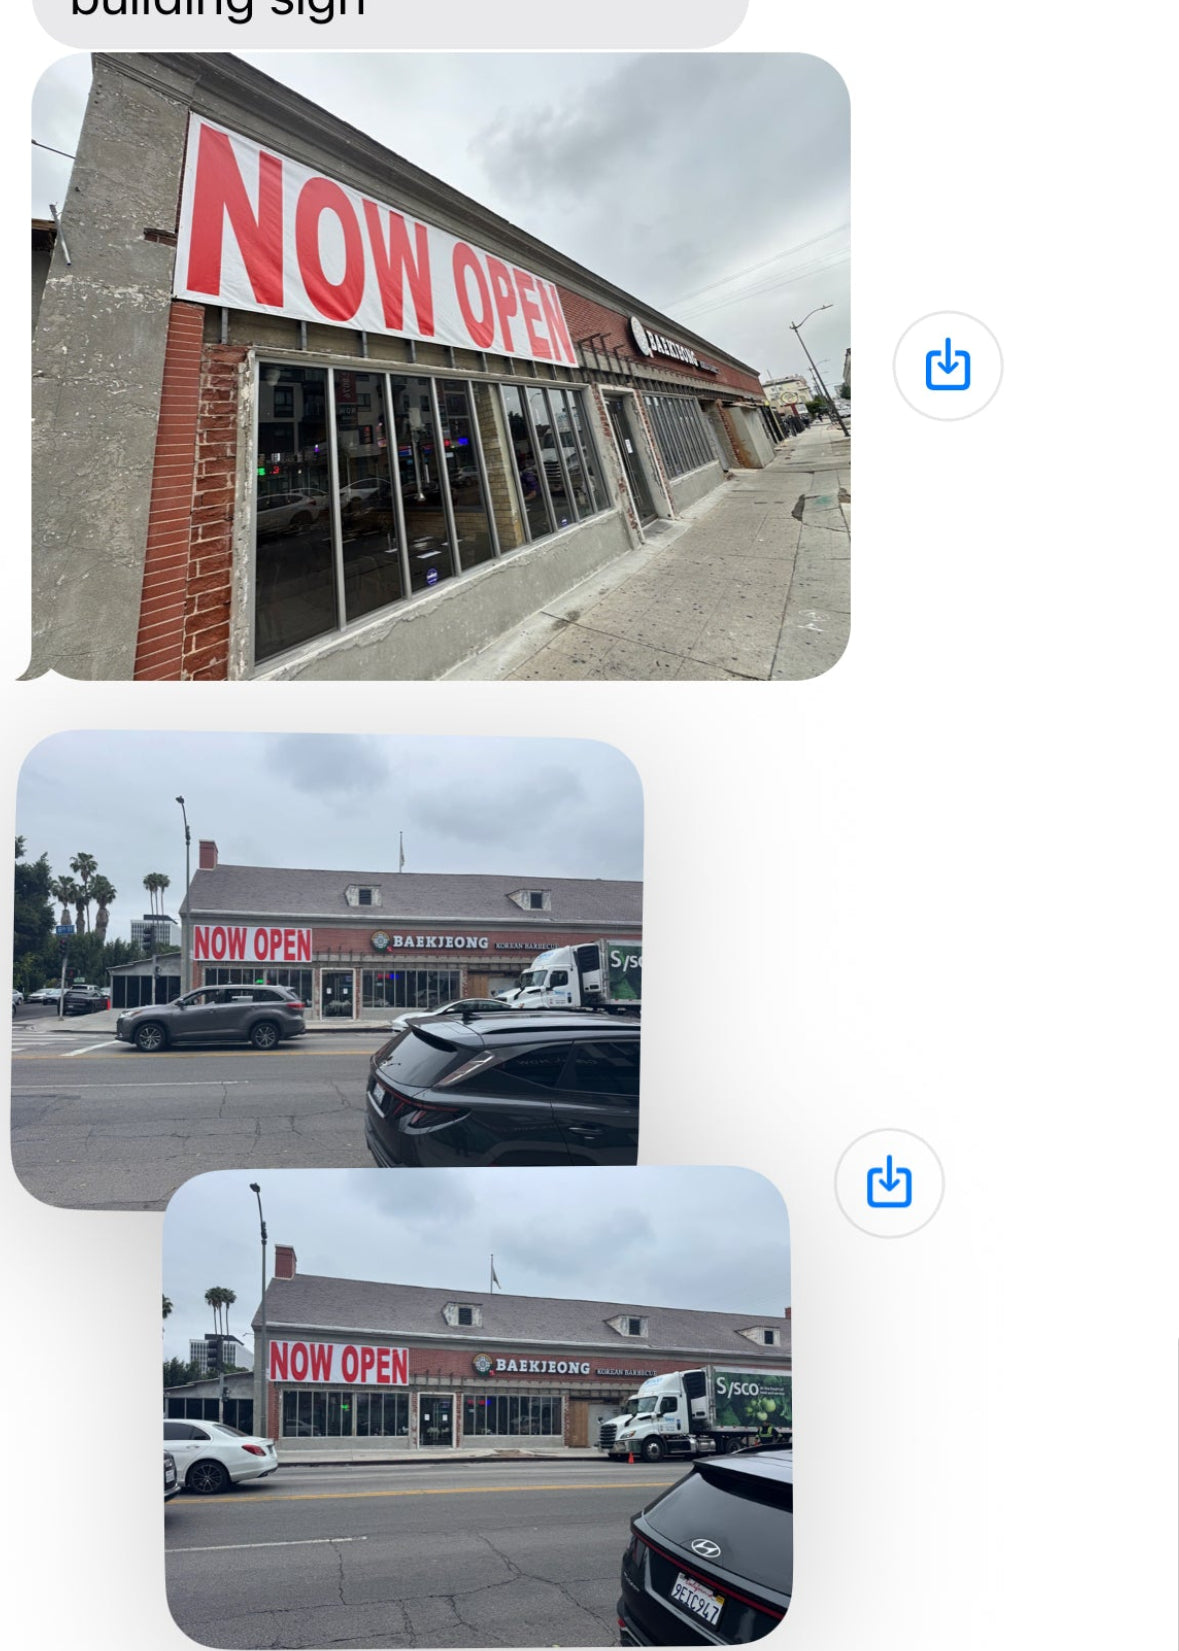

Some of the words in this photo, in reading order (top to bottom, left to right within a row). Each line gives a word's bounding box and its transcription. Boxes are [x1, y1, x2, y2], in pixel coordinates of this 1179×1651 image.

[186, 122, 435, 337] NOW
[452, 241, 576, 364] OPEN
[194, 925, 248, 961] NOW
[253, 927, 312, 962] OPEN
[393, 934, 489, 949] BAEKJEONG
[270, 1341, 334, 1381] NOW
[341, 1344, 408, 1385] OPEN
[496, 1358, 591, 1375] BAEKJEONG
[673, 1583, 720, 1622] 9EIC947
